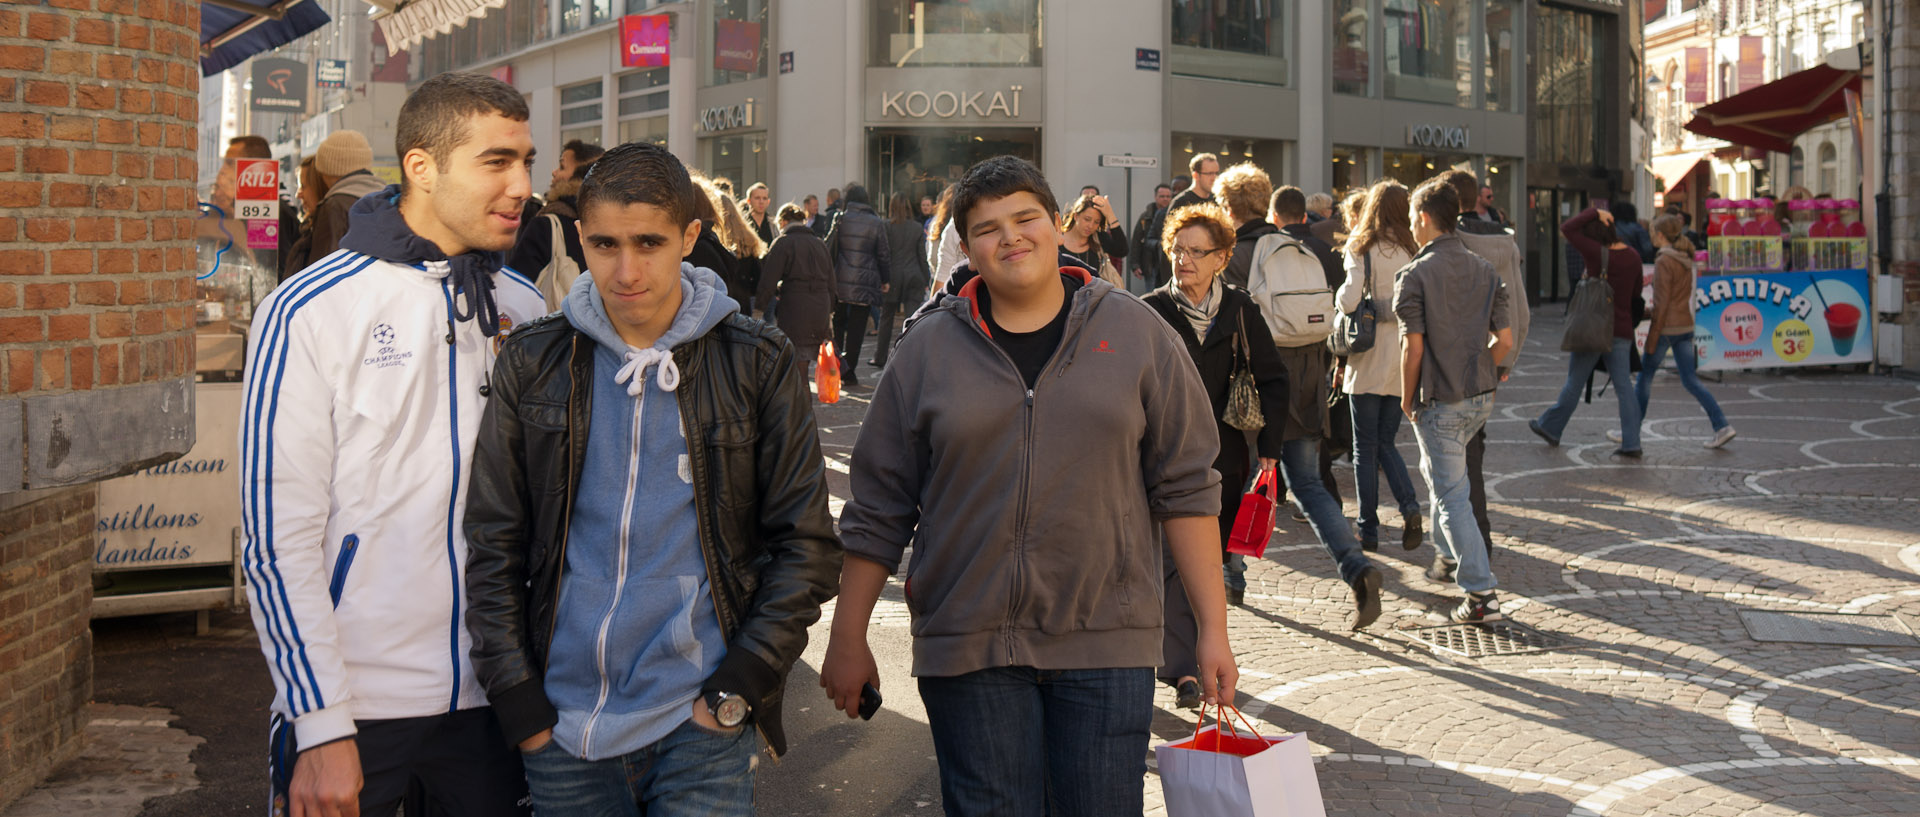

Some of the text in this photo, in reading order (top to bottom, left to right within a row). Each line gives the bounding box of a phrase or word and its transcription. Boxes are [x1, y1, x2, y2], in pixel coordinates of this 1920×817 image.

[882, 84, 1023, 118] KOOKAÏ
[240, 170, 276, 188] RTL2
[1725, 313, 1758, 324] le petit
[1775, 328, 1811, 338] le Géant
[364, 351, 413, 365] CHAMPIONS
[1724, 348, 1763, 359] MIGNON
[377, 360, 403, 369] LEAGUE
[135, 459, 229, 477] aison
[97, 503, 204, 533] stillons
[96, 537, 197, 565] landais
